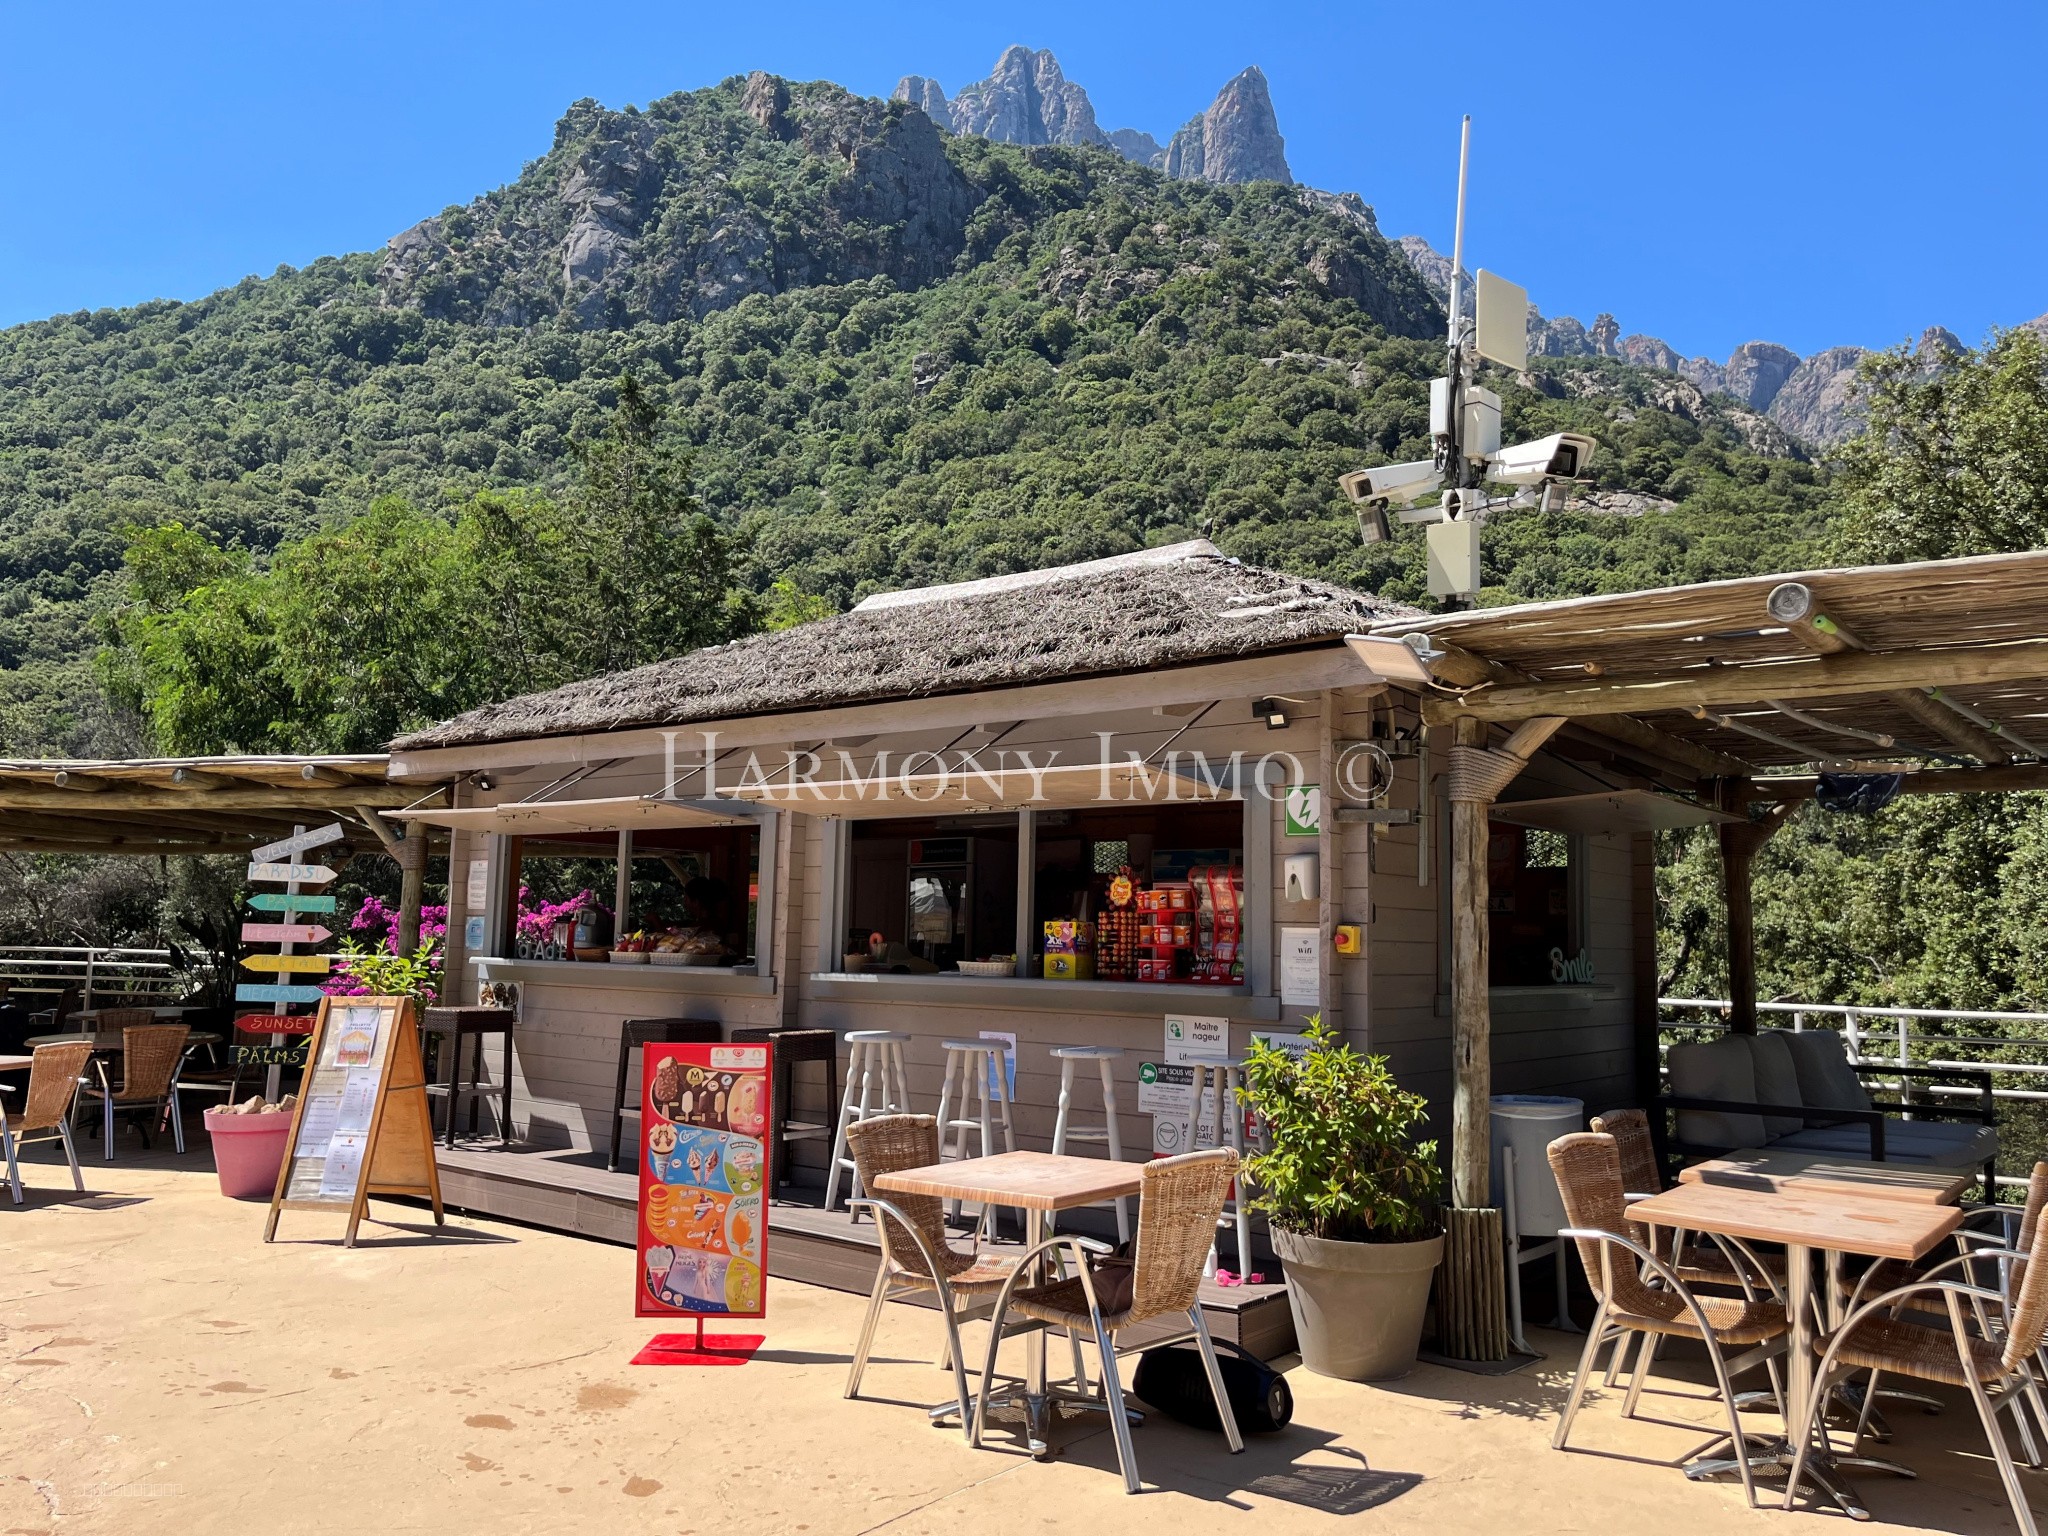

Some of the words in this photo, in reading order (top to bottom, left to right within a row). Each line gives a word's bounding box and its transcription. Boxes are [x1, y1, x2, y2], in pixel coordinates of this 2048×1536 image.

[255, 834, 321, 861] WELCOME
[266, 895, 329, 911] PARTY
[1550, 947, 1595, 983] Smile
[250, 1016, 317, 1029] SUNSET
[1192, 1033, 1220, 1042] nageur
[237, 1047, 301, 1064] PALMS
[1169, 1068, 1183, 1076] SOUS
